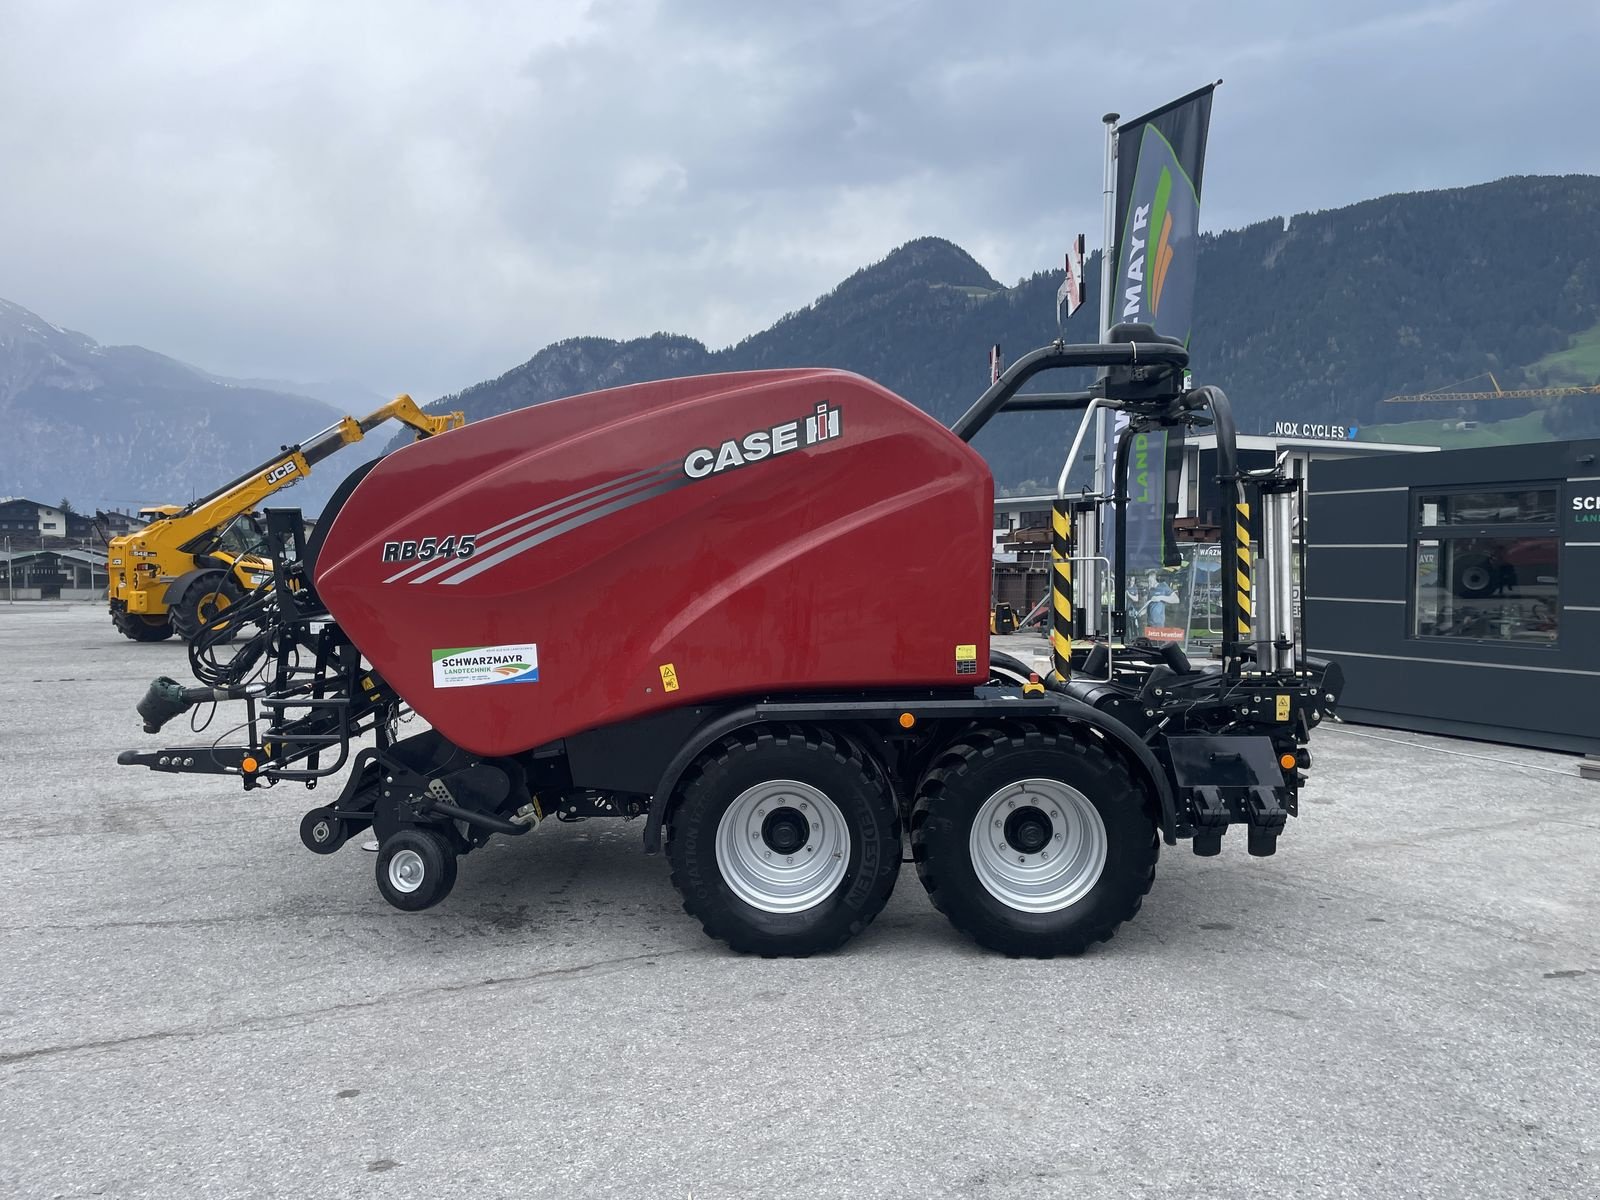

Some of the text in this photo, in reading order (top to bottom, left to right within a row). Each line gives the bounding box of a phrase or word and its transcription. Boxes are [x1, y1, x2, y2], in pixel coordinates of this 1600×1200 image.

[1302, 423, 1345, 438] CYCLES
[684, 421, 798, 478] CASE
[267, 461, 297, 484] JCB
[1575, 514, 1600, 523] LAN
[382, 535, 477, 562] RB545
[442, 654, 523, 668] SCHWARZMAYR
[444, 667, 491, 675] LANDTECHNIK
